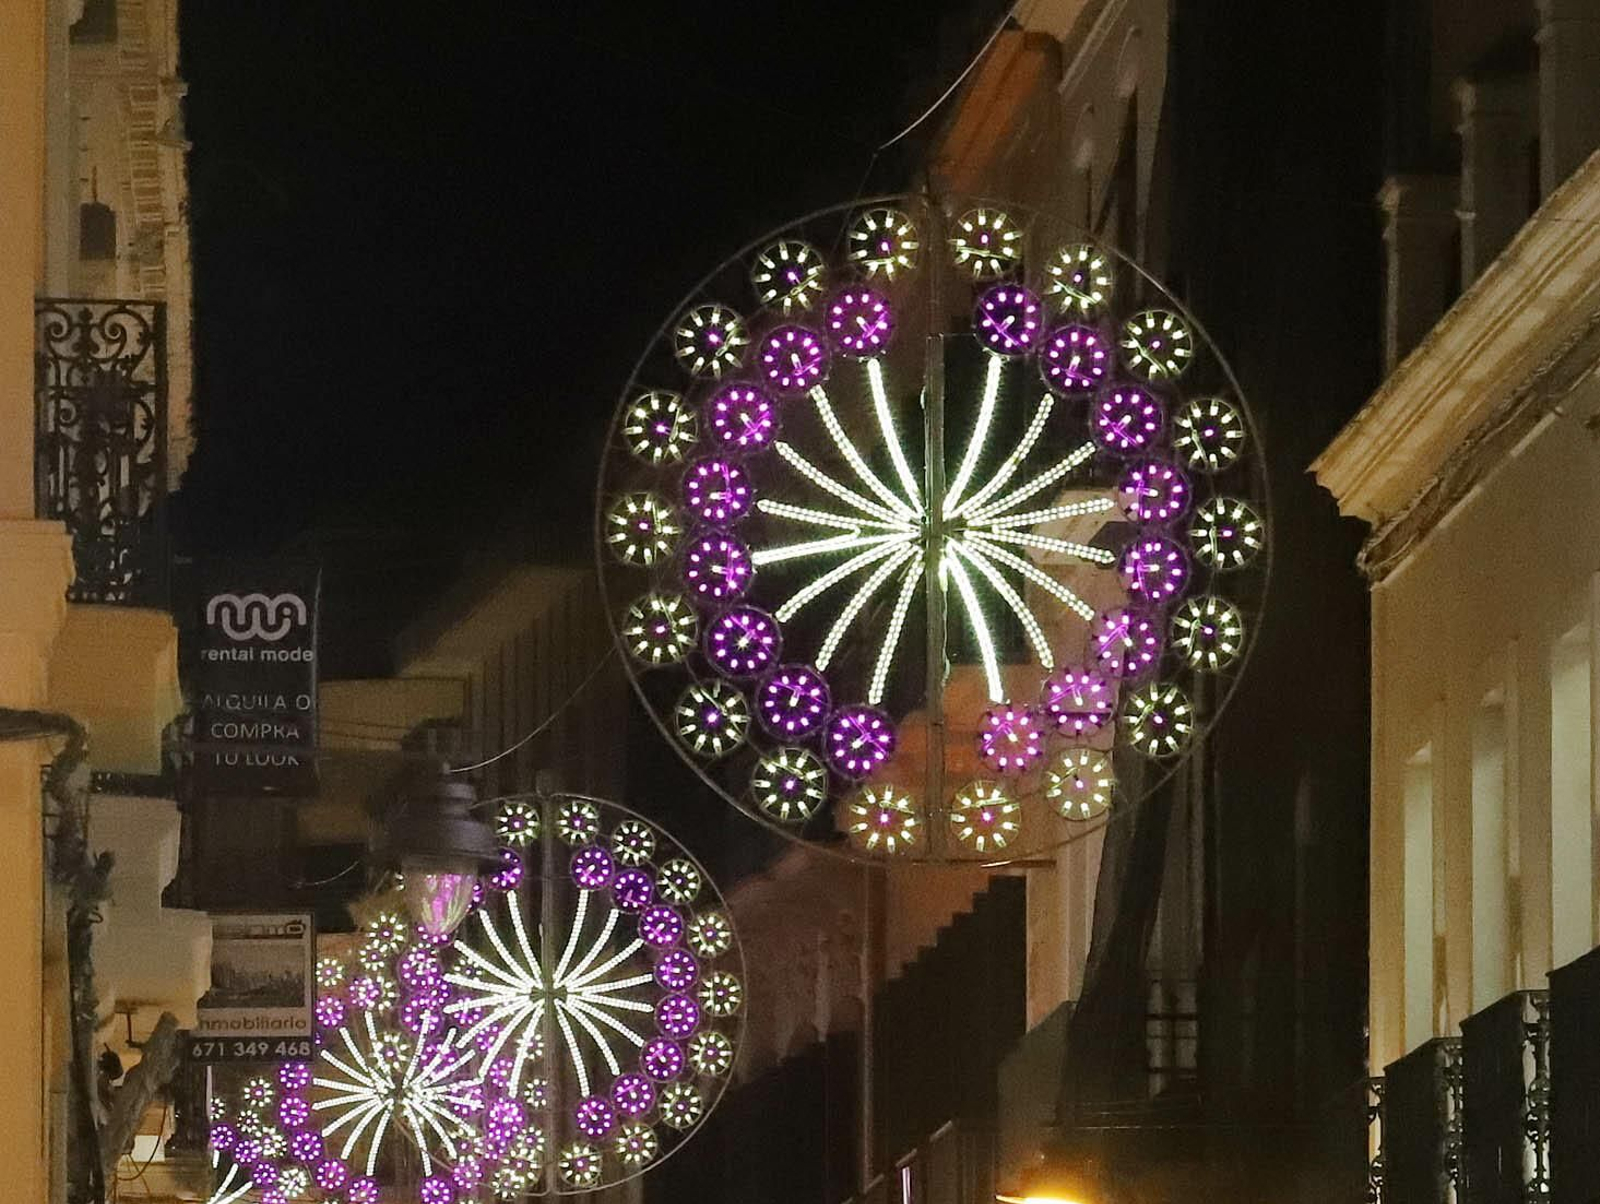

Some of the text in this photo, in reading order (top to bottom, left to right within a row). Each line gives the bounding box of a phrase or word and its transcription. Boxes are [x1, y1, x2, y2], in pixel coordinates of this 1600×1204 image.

[202, 647, 314, 661] rental mode
[296, 694, 311, 710] O
[211, 723, 299, 739] COMPRA
[215, 752, 238, 766] TU
[198, 1015, 307, 1032] nmobiliario
[192, 1040, 311, 1057] 671 349 468
